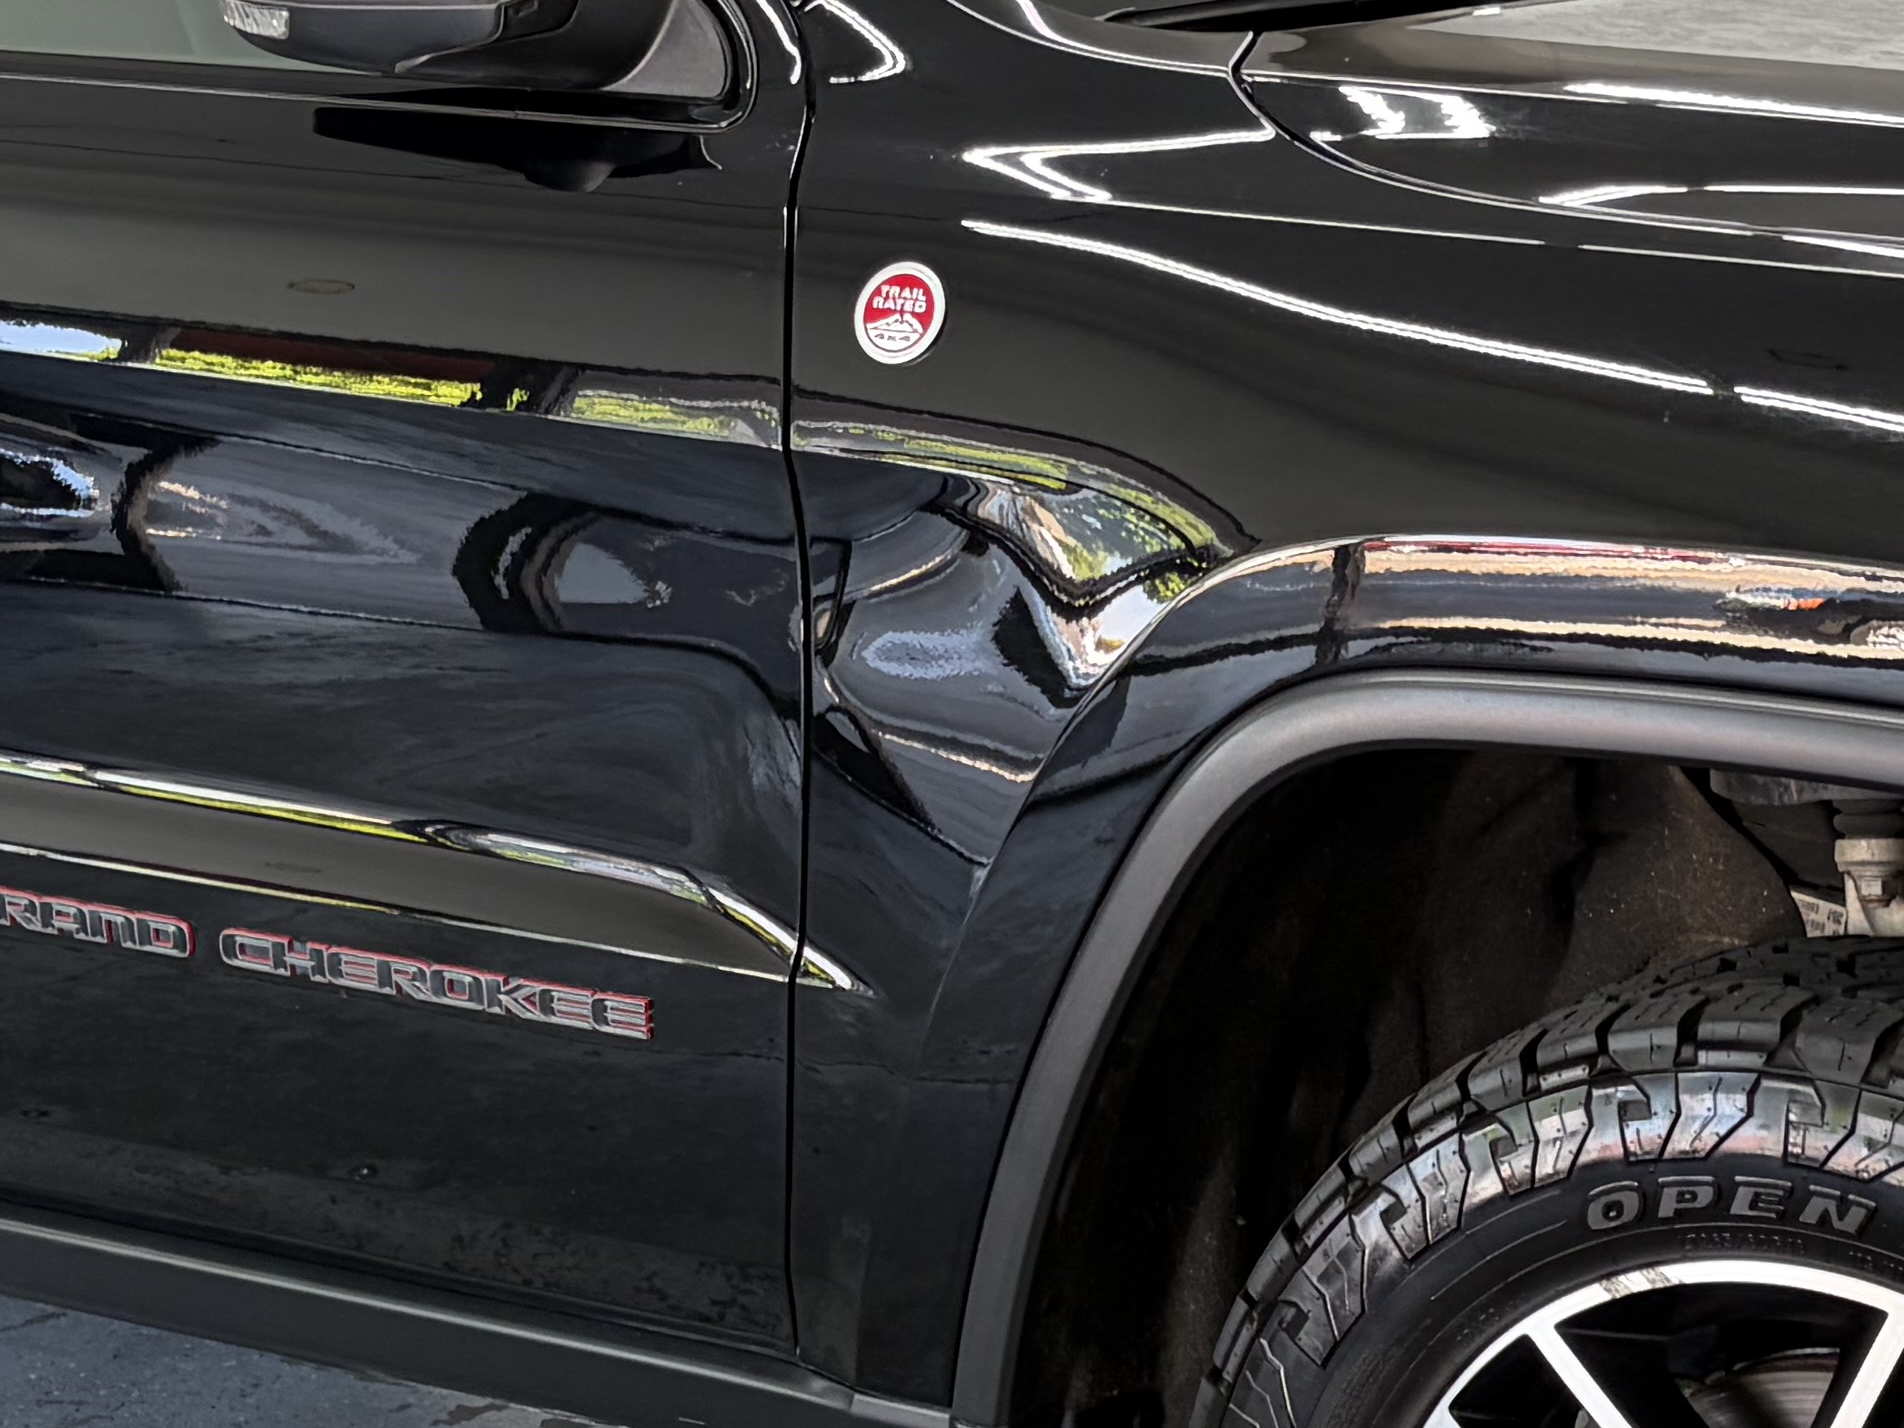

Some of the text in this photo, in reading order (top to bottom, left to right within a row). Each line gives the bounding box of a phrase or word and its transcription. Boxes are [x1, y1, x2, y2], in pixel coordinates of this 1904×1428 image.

[872, 295, 927, 314] RATED
[881, 284, 926, 301] TRAIL
[219, 927, 655, 1040] CHEROKEE
[1586, 1174, 1879, 1236] OPEN
